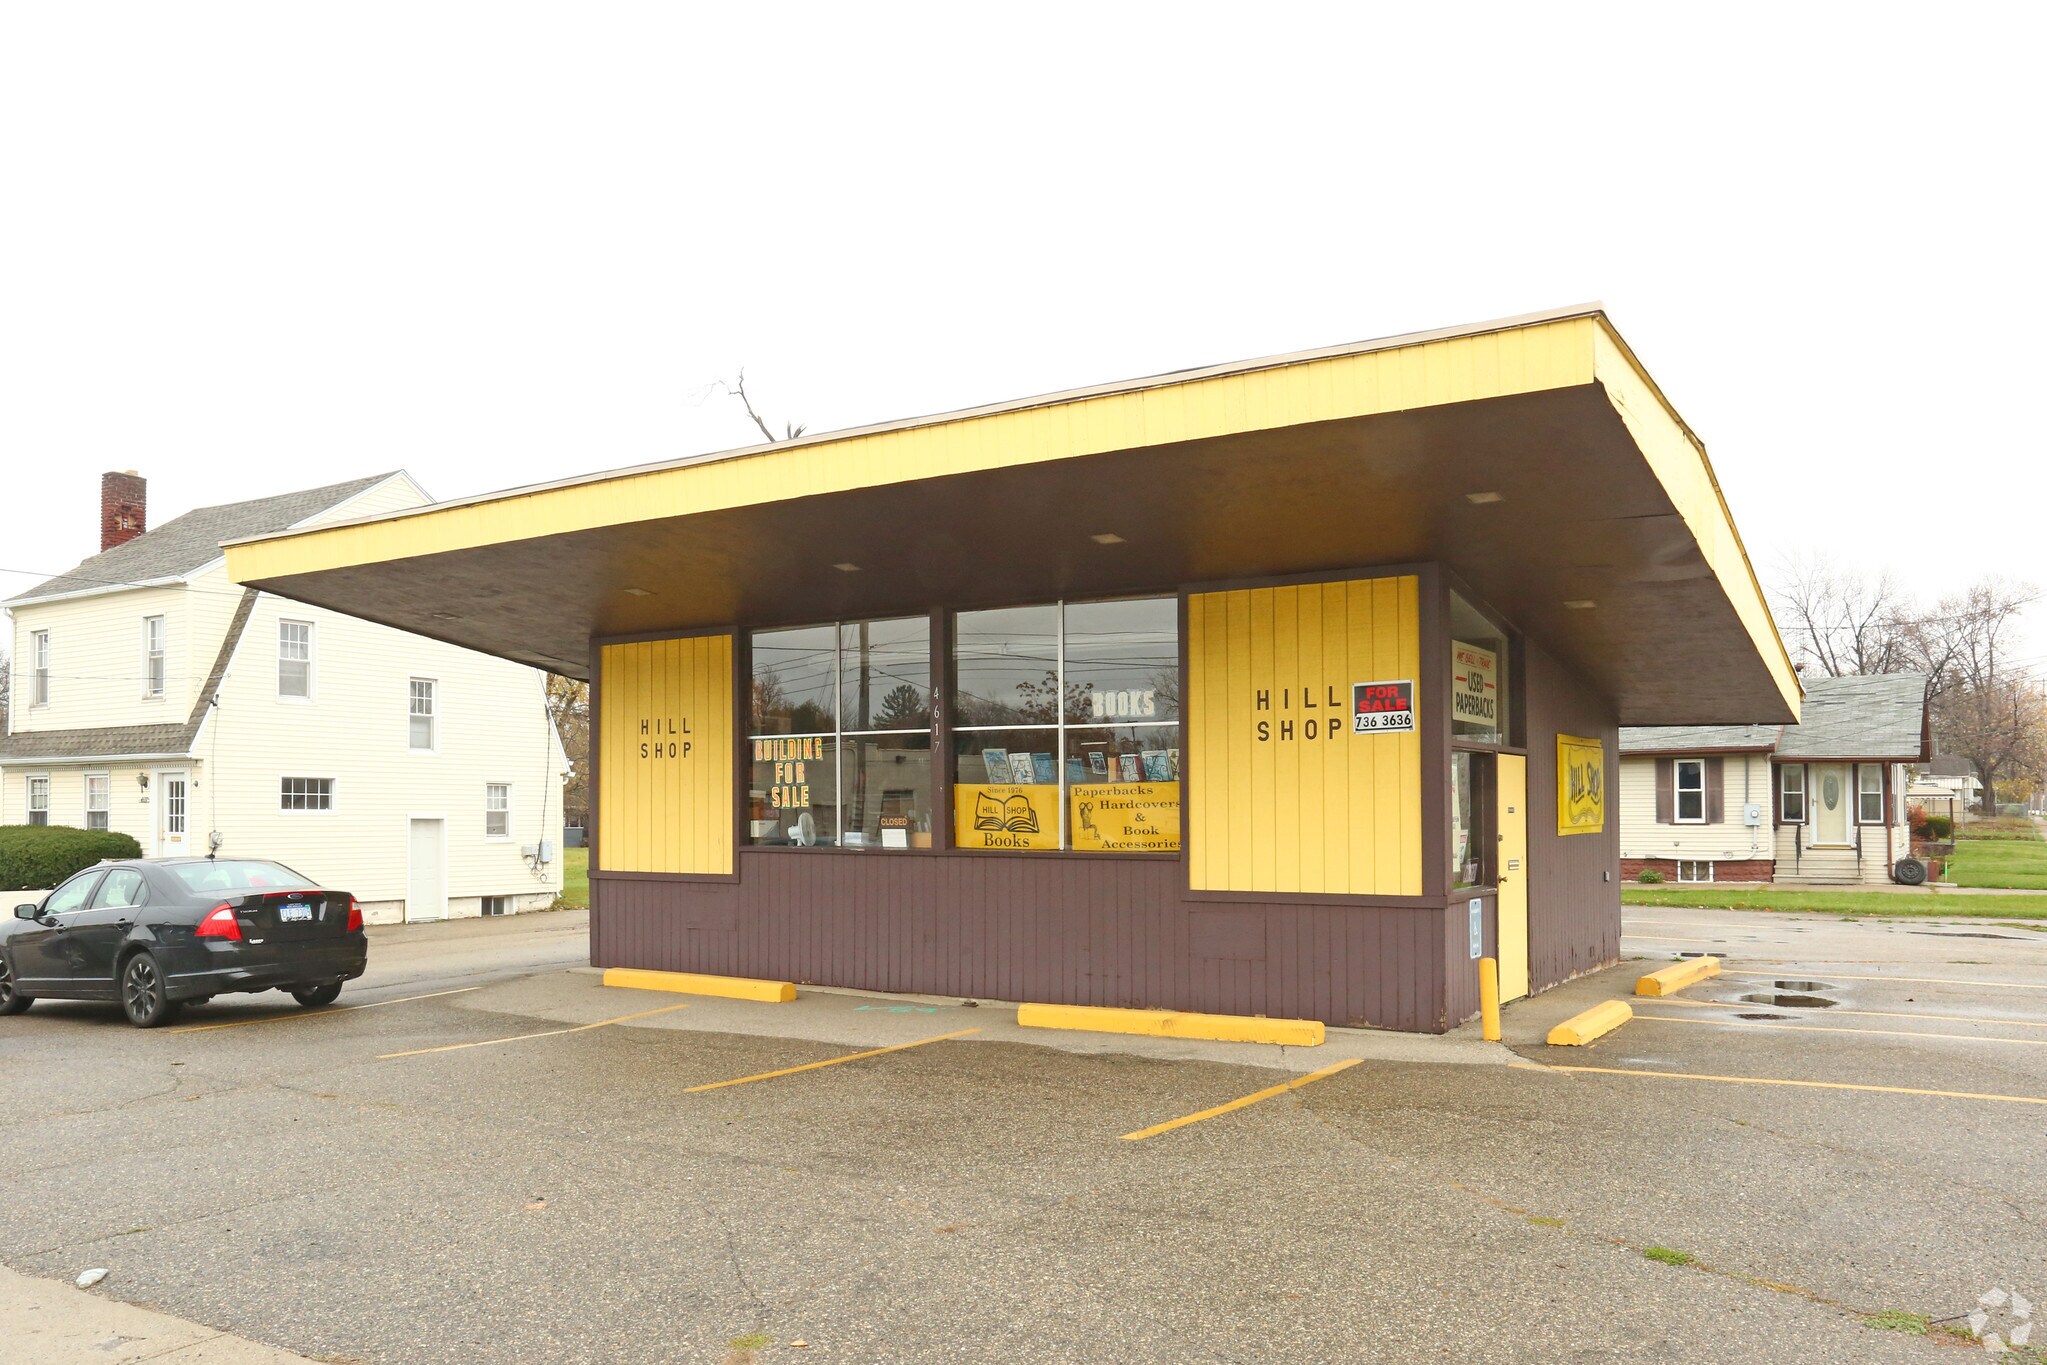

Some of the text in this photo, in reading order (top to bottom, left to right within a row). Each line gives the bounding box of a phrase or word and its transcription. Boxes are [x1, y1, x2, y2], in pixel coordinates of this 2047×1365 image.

[1467, 671, 1484, 693] USED
[1257, 686, 1342, 711] HILL
[1365, 686, 1399, 699] FOR
[1092, 690, 1155, 717] BOOKS
[1359, 698, 1408, 713] SALE
[1456, 692, 1494, 719] PAPERBACKS
[641, 717, 691, 735] HILL
[1356, 714, 1411, 728] 736 3636
[1257, 718, 1342, 742] SHOP
[641, 742, 692, 759] SHOP
[755, 738, 823, 761] BUILDING
[775, 762, 805, 784] FOR
[771, 786, 809, 808] SALE
[1074, 785, 1154, 798] Paperbacks
[983, 806, 1027, 815] HILL SHOP
[1135, 812, 1146, 822] &
[880, 817, 908, 826] CLOSED
[1123, 826, 1159, 836] Book
[984, 832, 1030, 848] Books
